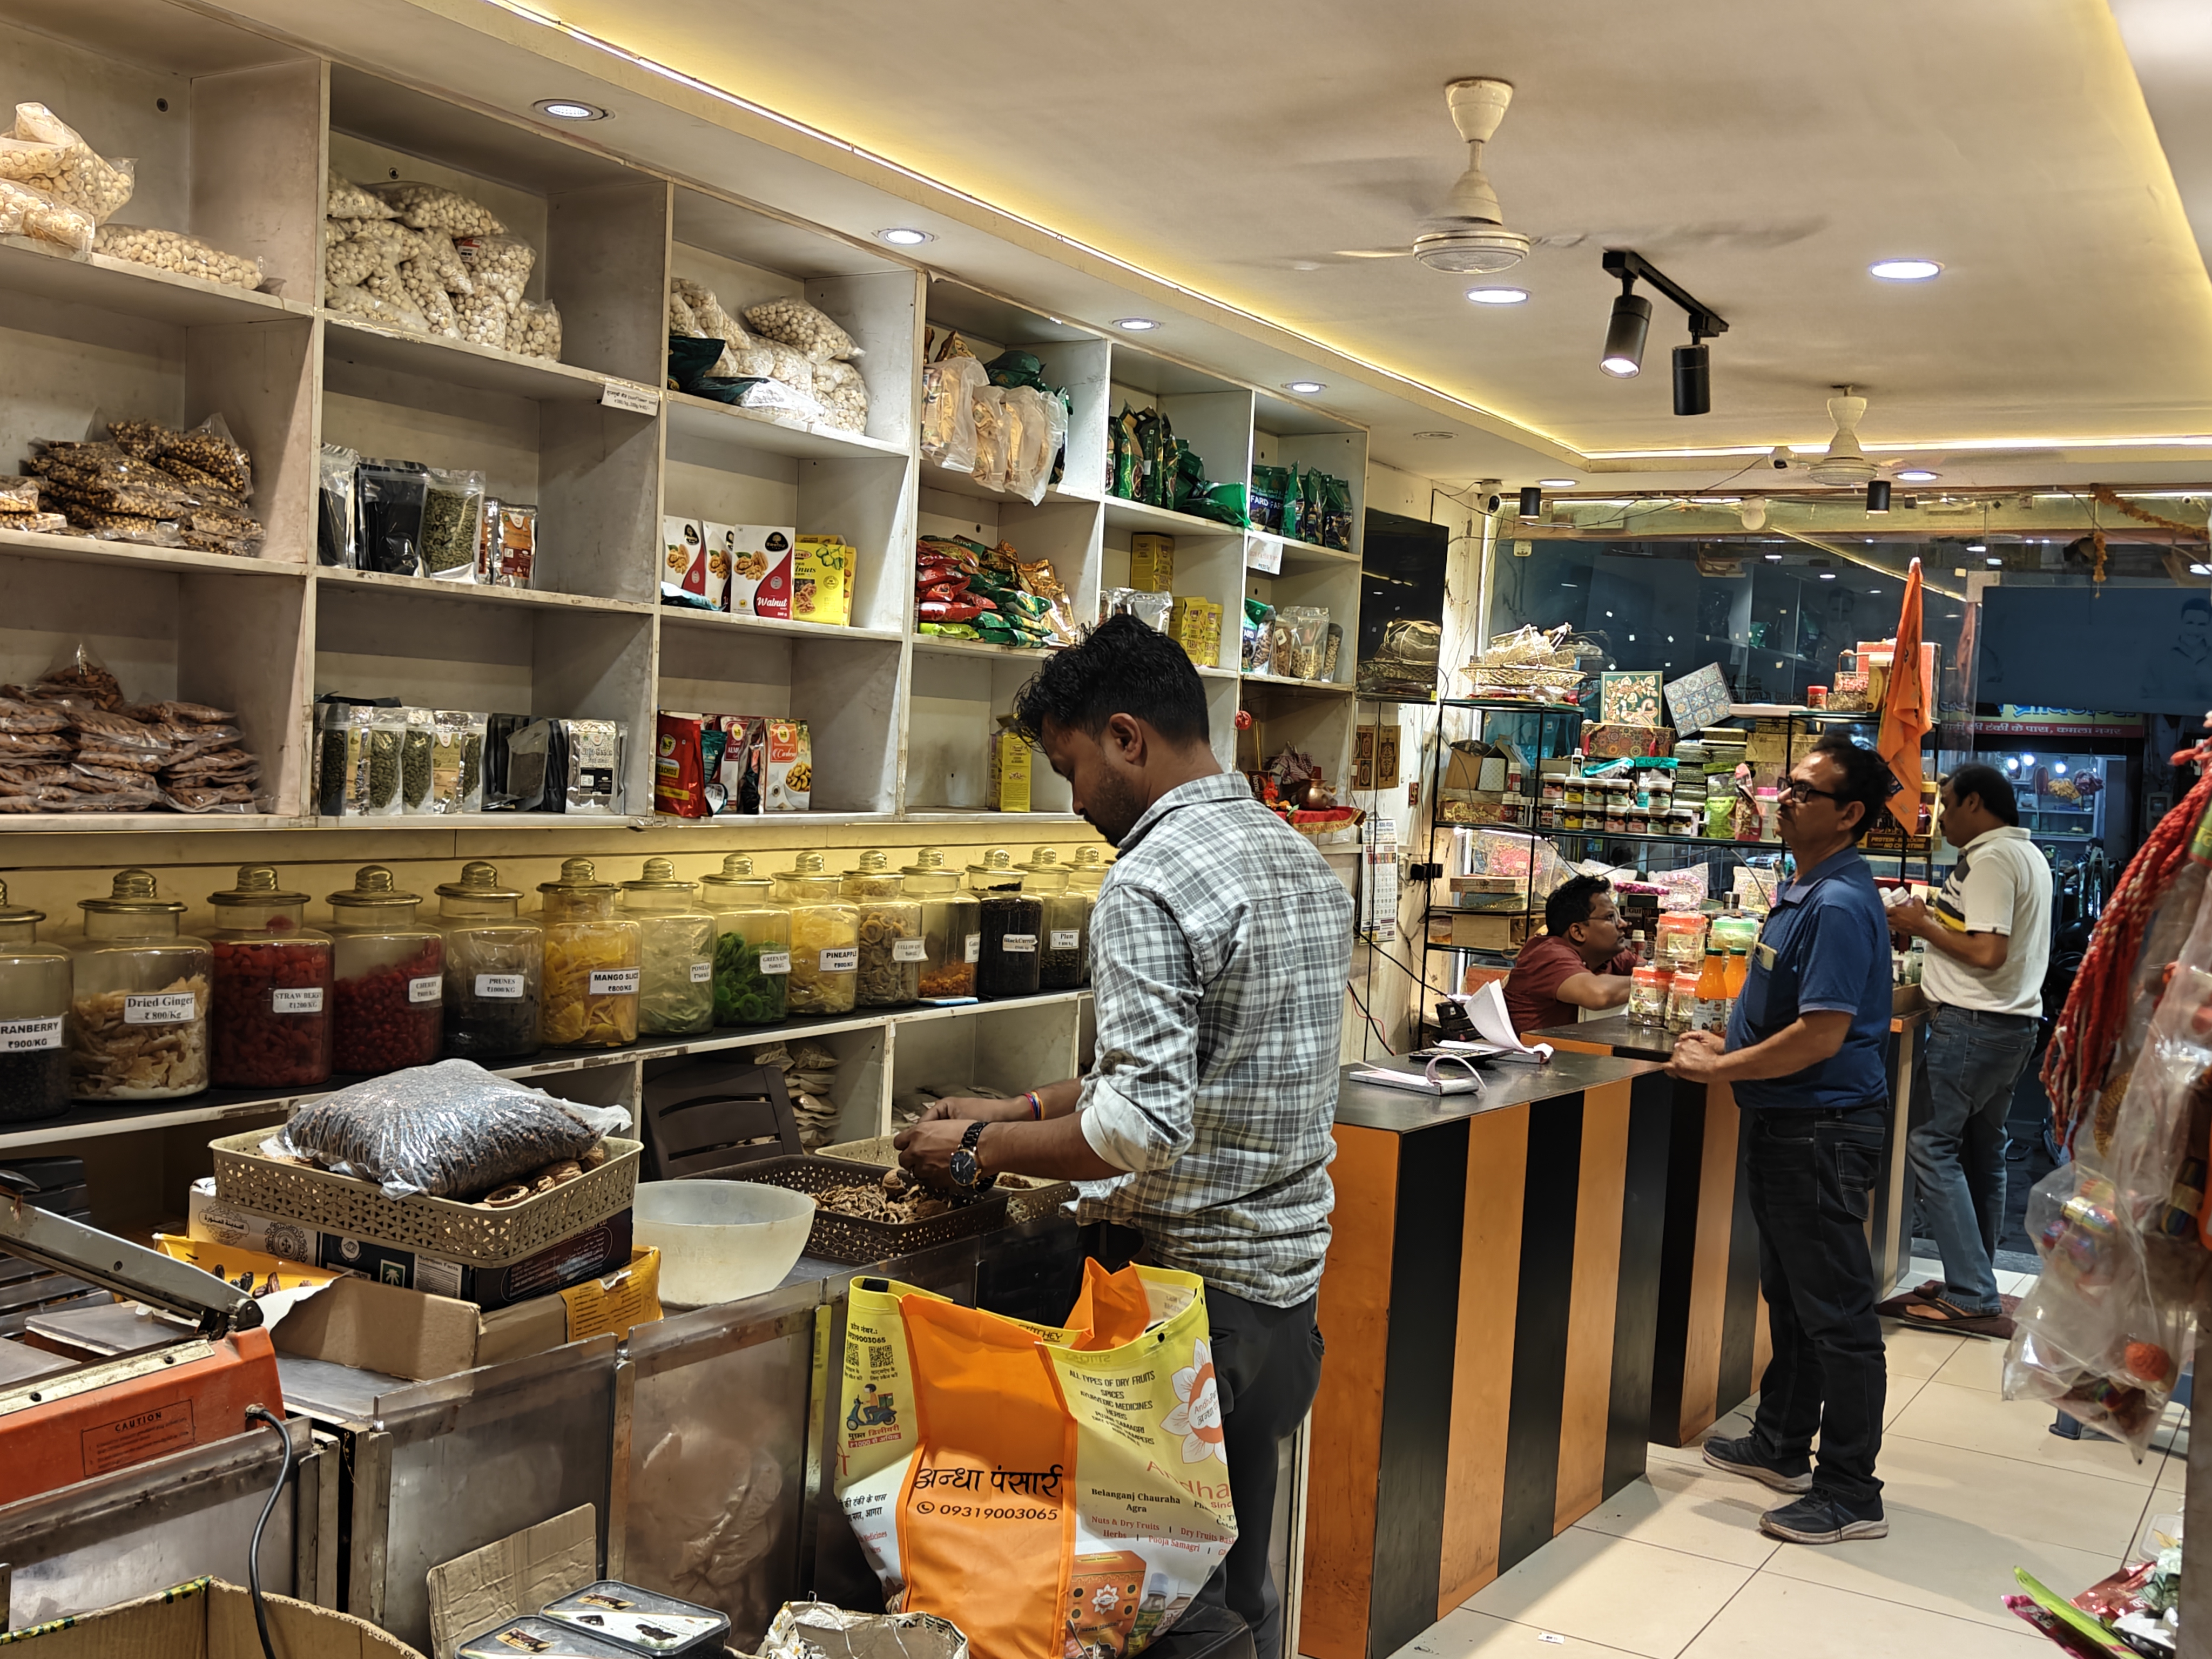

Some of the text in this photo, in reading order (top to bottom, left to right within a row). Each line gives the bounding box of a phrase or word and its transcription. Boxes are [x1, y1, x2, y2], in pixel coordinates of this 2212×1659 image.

[1251, 495, 1269, 507] FARD
[1270, 501, 1283, 510] FAR
[757, 596, 787, 607] Walnut
[1243, 630, 1254, 639] ARD
[2011, 724, 2024, 732] के
[127, 996, 193, 1008] Dried Ginger
[0, 1021, 59, 1035] RANBERRY
[8, 1038, 48, 1049] ₹900/KG
[1069, 1370, 1156, 1387] ALL TYPES OF DRY FRUITS
[1101, 1389, 1125, 1399] SPICES
[1115, 1400, 1154, 1411] MEDICINES
[1105, 1407, 1128, 1421] HERBS
[114, 1412, 162, 1433] CAUTION
[914, 1467, 984, 1493] अन्धा
[866, 1494, 873, 1503] के
[874, 1493, 887, 1502] पास
[1091, 1488, 1181, 1505] Belanganj Chauraha
[865, 1507, 882, 1518] आगरा
[940, 1504, 1058, 1521] 09319003065
[1126, 1503, 1148, 1514] Agra
[1091, 1515, 1110, 1525] Nuts
[1120, 1519, 1134, 1529] Dry
[1136, 1521, 1160, 1531] Fruits
[1103, 1529, 1127, 1539] Herbs
[1181, 1527, 1194, 1538] Dry
[1196, 1530, 1218, 1542] Fruits
[1148, 1535, 1201, 1552] Pooja Samagri
